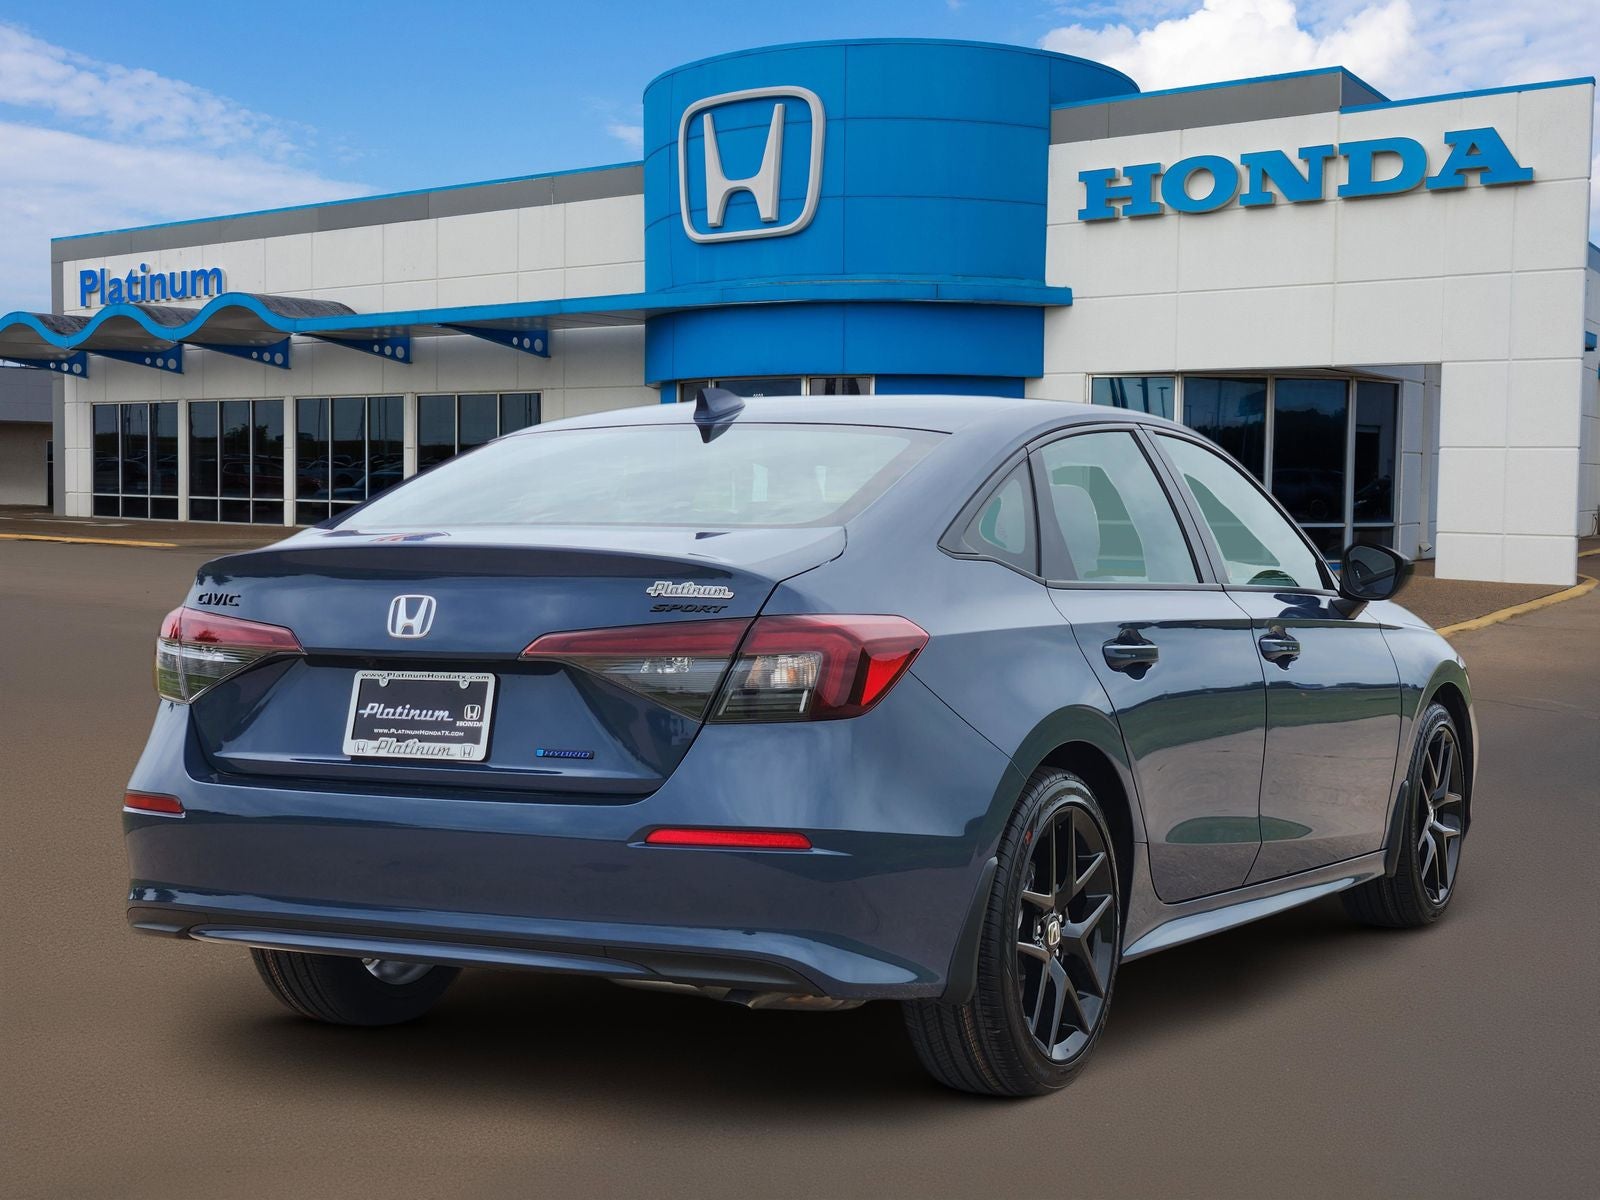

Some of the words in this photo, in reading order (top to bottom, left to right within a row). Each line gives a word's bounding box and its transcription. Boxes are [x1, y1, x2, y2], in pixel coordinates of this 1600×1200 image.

[1078, 127, 1534, 221] HONDA
[79, 262, 226, 308] Platinum
[647, 581, 734, 598] Platinum
[198, 593, 241, 607] CIVIC
[650, 604, 728, 613] SPORT
[359, 703, 453, 721] Platinum
[371, 739, 456, 756] Platinum
[544, 750, 590, 758] HYBRID
